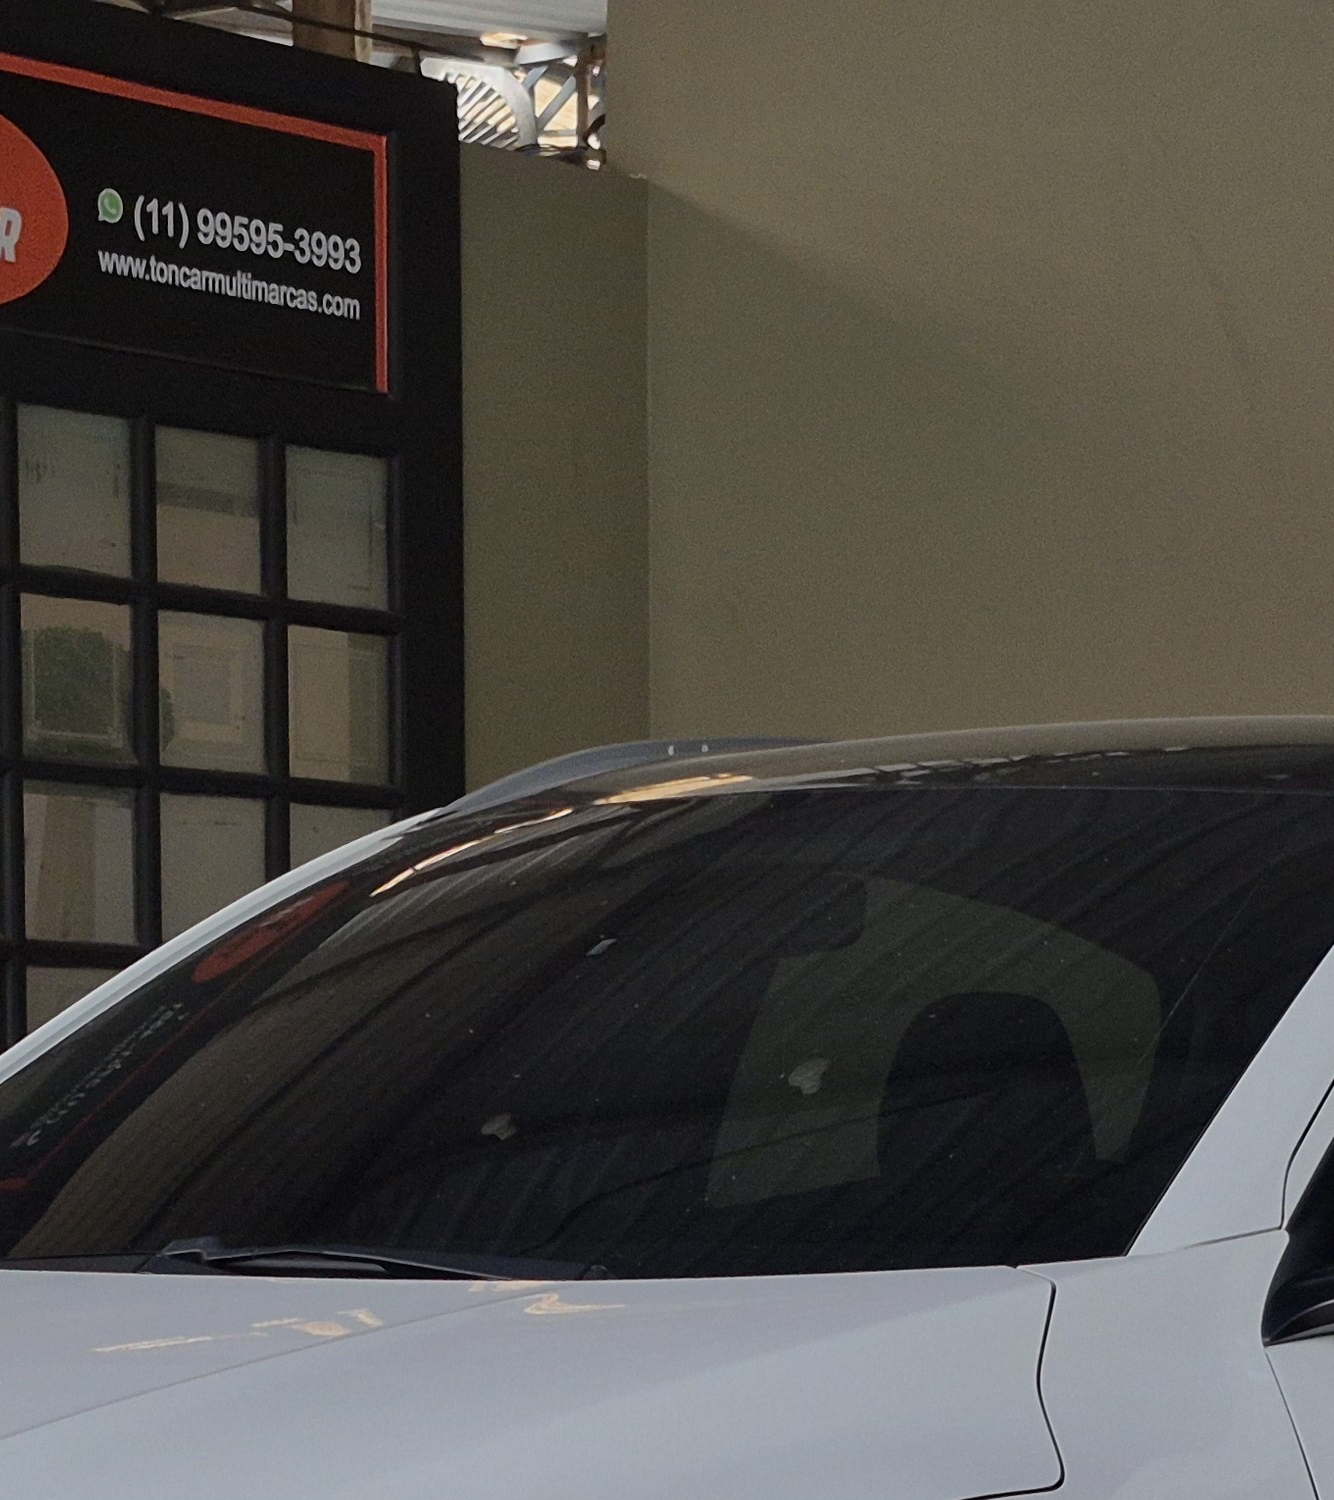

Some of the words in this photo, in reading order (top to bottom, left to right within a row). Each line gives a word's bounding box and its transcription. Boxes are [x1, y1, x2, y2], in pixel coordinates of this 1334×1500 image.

[134, 195, 190, 249] (11)
[197, 208, 362, 274] 99595-3993
[97, 250, 361, 321] www.toncarmultimarcas.com
